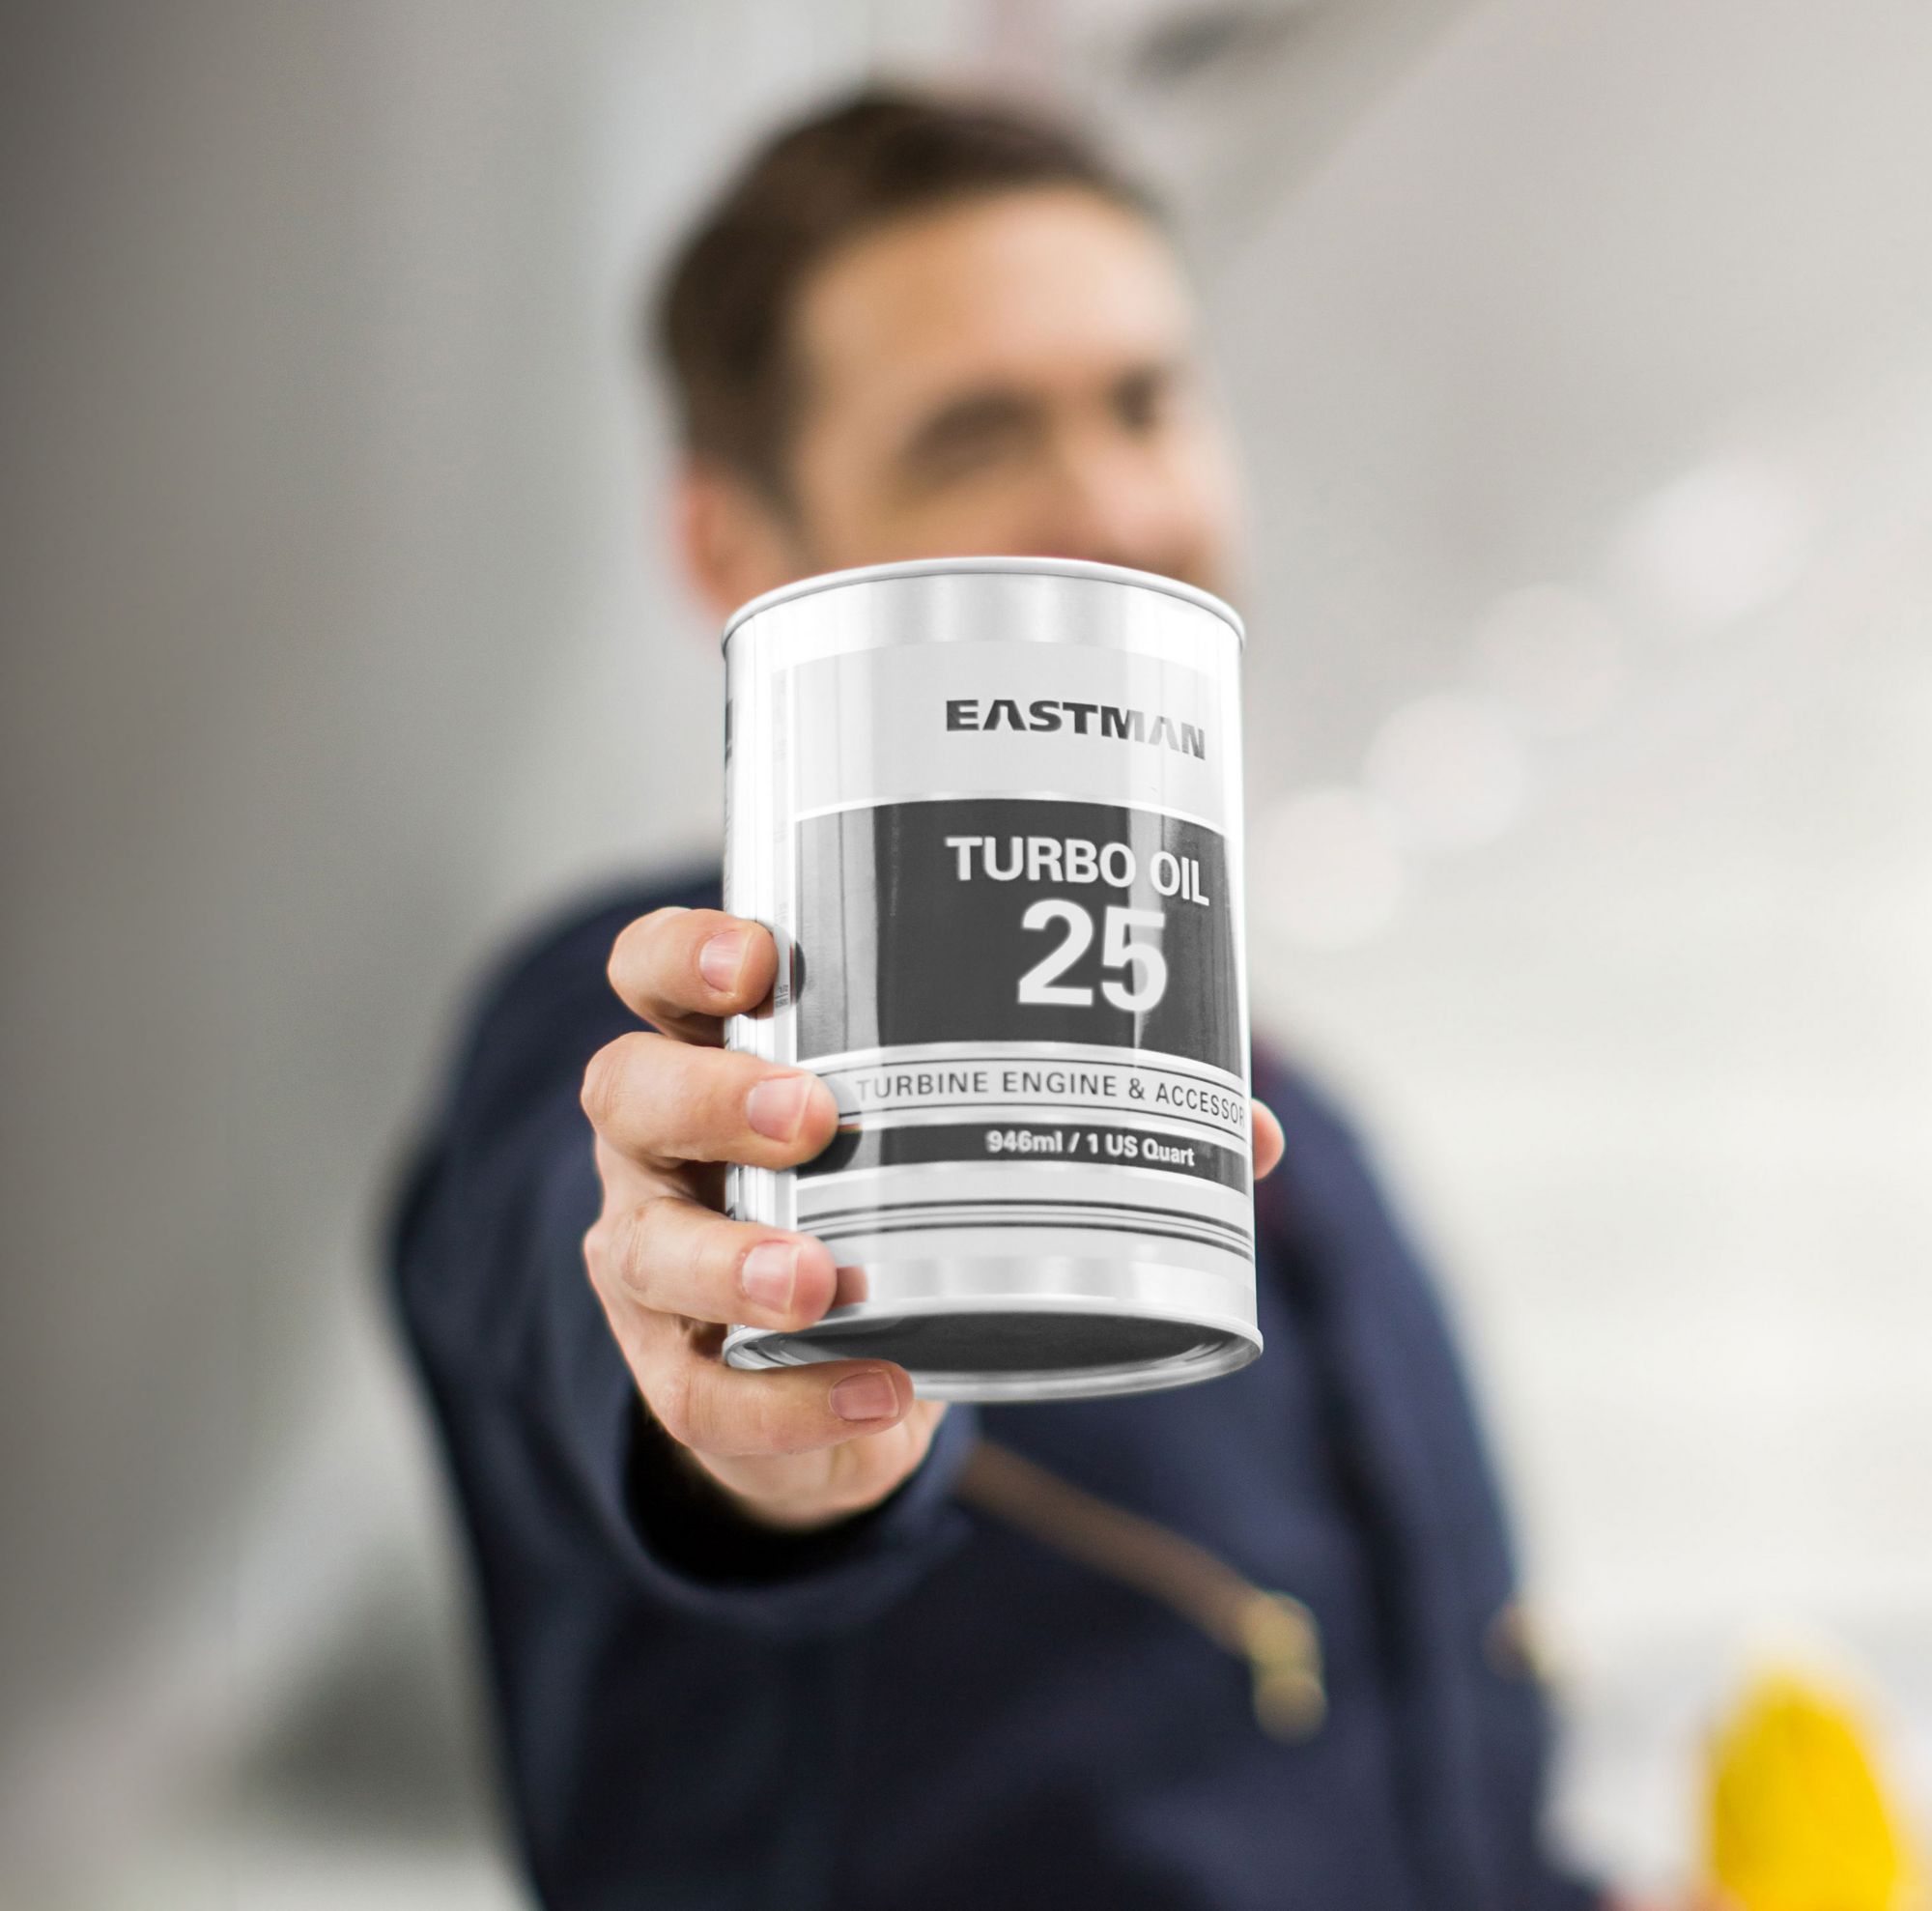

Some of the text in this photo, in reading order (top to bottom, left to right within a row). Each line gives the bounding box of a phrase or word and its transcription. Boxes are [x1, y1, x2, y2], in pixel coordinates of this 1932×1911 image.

[946, 699, 1206, 760] EASTMAN
[946, 837, 1209, 906] TURBO OIL
[1018, 898, 1167, 1013] 25
[857, 1071, 988, 1101] TURBINE
[1003, 1070, 1117, 1098] ENGINE
[1128, 1077, 1145, 1099] &
[985, 1129, 1196, 1167] 946ml / 1 US Quart
